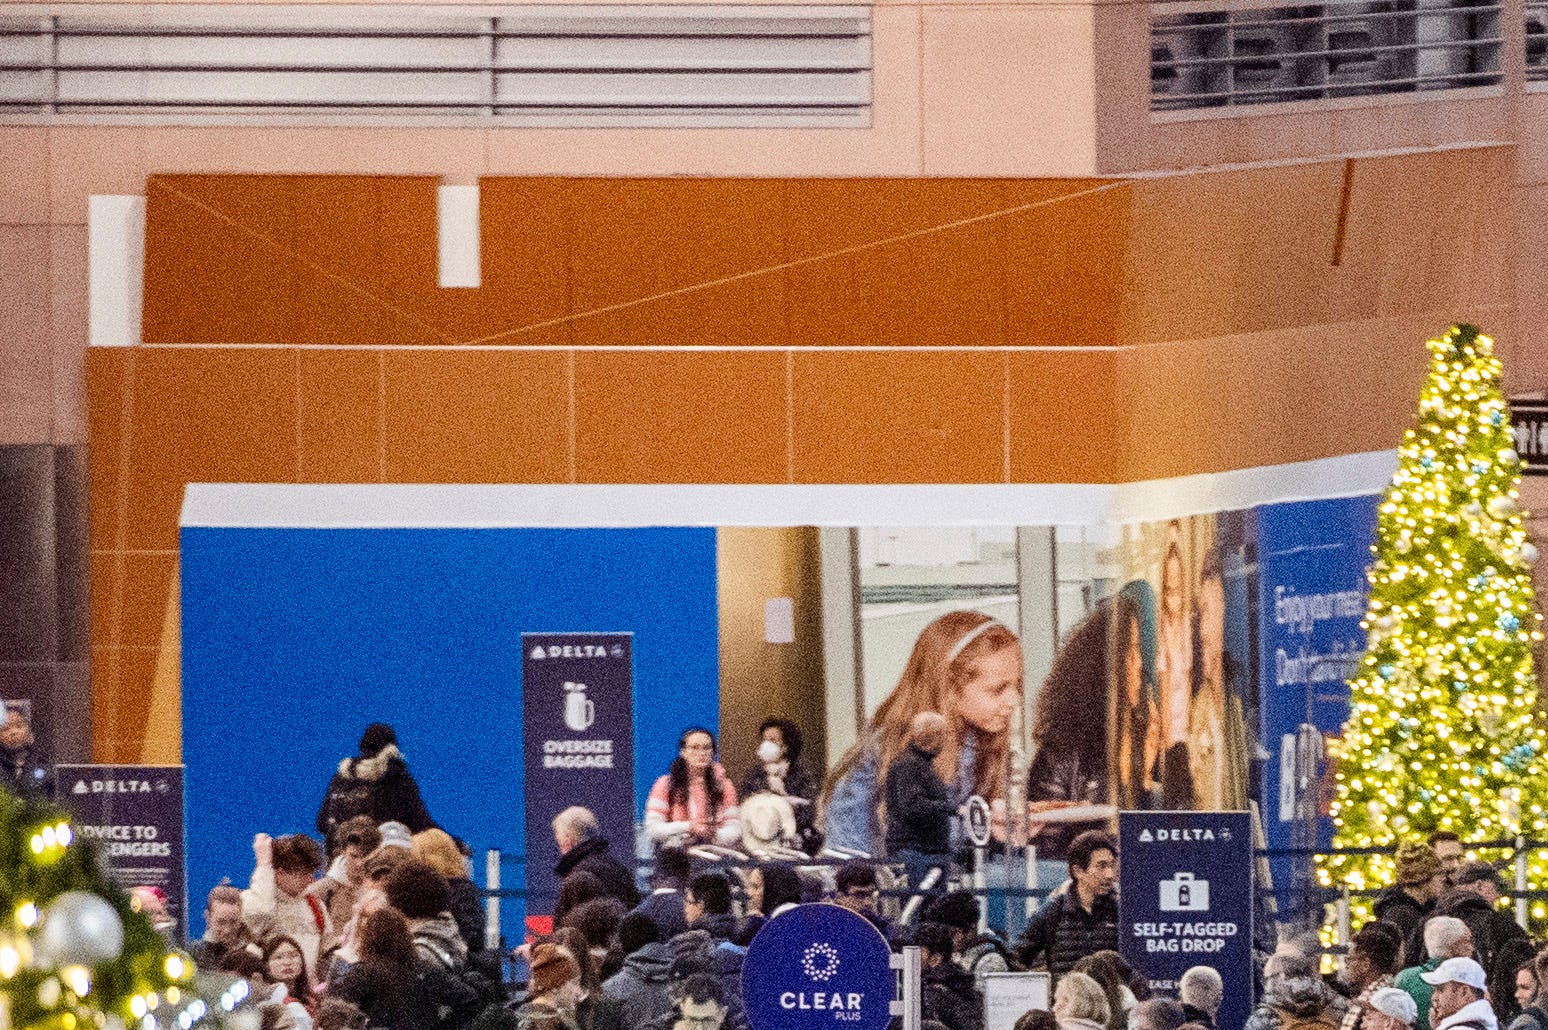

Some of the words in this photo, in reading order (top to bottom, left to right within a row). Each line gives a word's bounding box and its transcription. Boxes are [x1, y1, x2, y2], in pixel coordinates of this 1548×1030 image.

[548, 645, 607, 658] DELTA
[543, 740, 613, 753] OVERSIZE
[543, 754, 614, 769] BAGGAGE
[92, 780, 151, 793] DELTA
[132, 825, 158, 840] TO
[1157, 829, 1215, 841] DELTA
[110, 841, 171, 857] ENGERS
[1133, 922, 1238, 937] SELF-TAGGED
[1146, 939, 1179, 953] BAG
[1181, 939, 1226, 953] DROP
[780, 991, 861, 1010] CLEAR
[835, 1011, 861, 1021] PLUS
